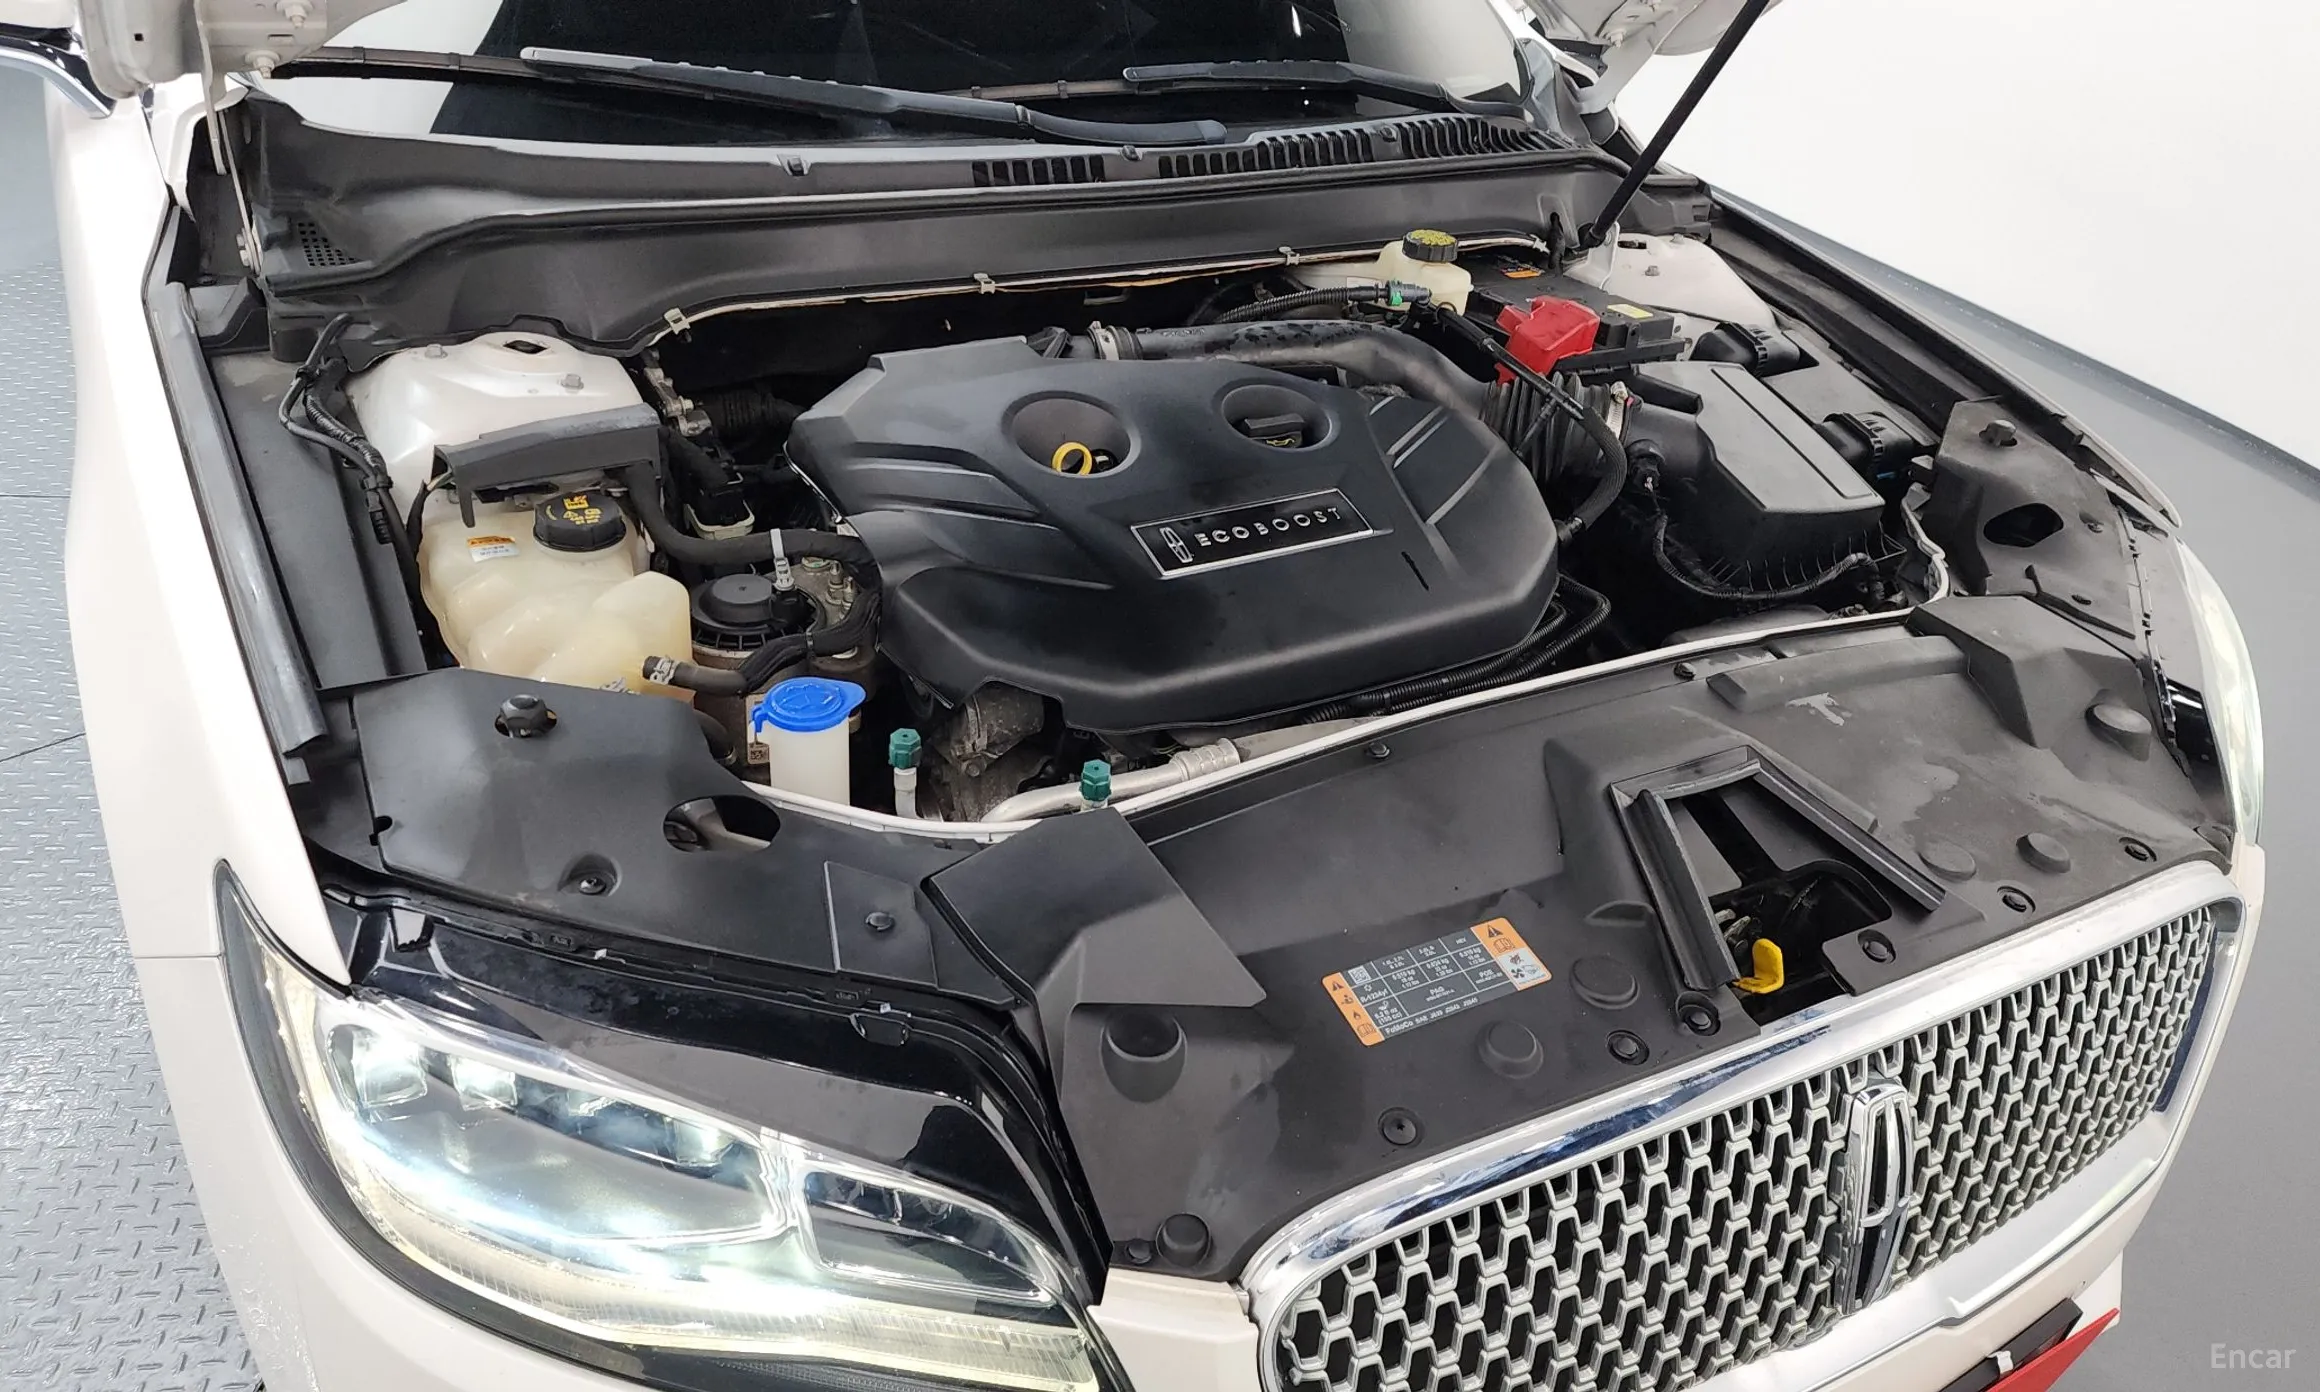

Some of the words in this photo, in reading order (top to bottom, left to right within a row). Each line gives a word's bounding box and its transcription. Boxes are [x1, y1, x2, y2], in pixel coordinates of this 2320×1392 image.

[1195, 508, 1340, 547] ECOBOOST
[1360, 988, 1388, 1003] R-1234yf
[1385, 1021, 1414, 1034] FoMoCo
